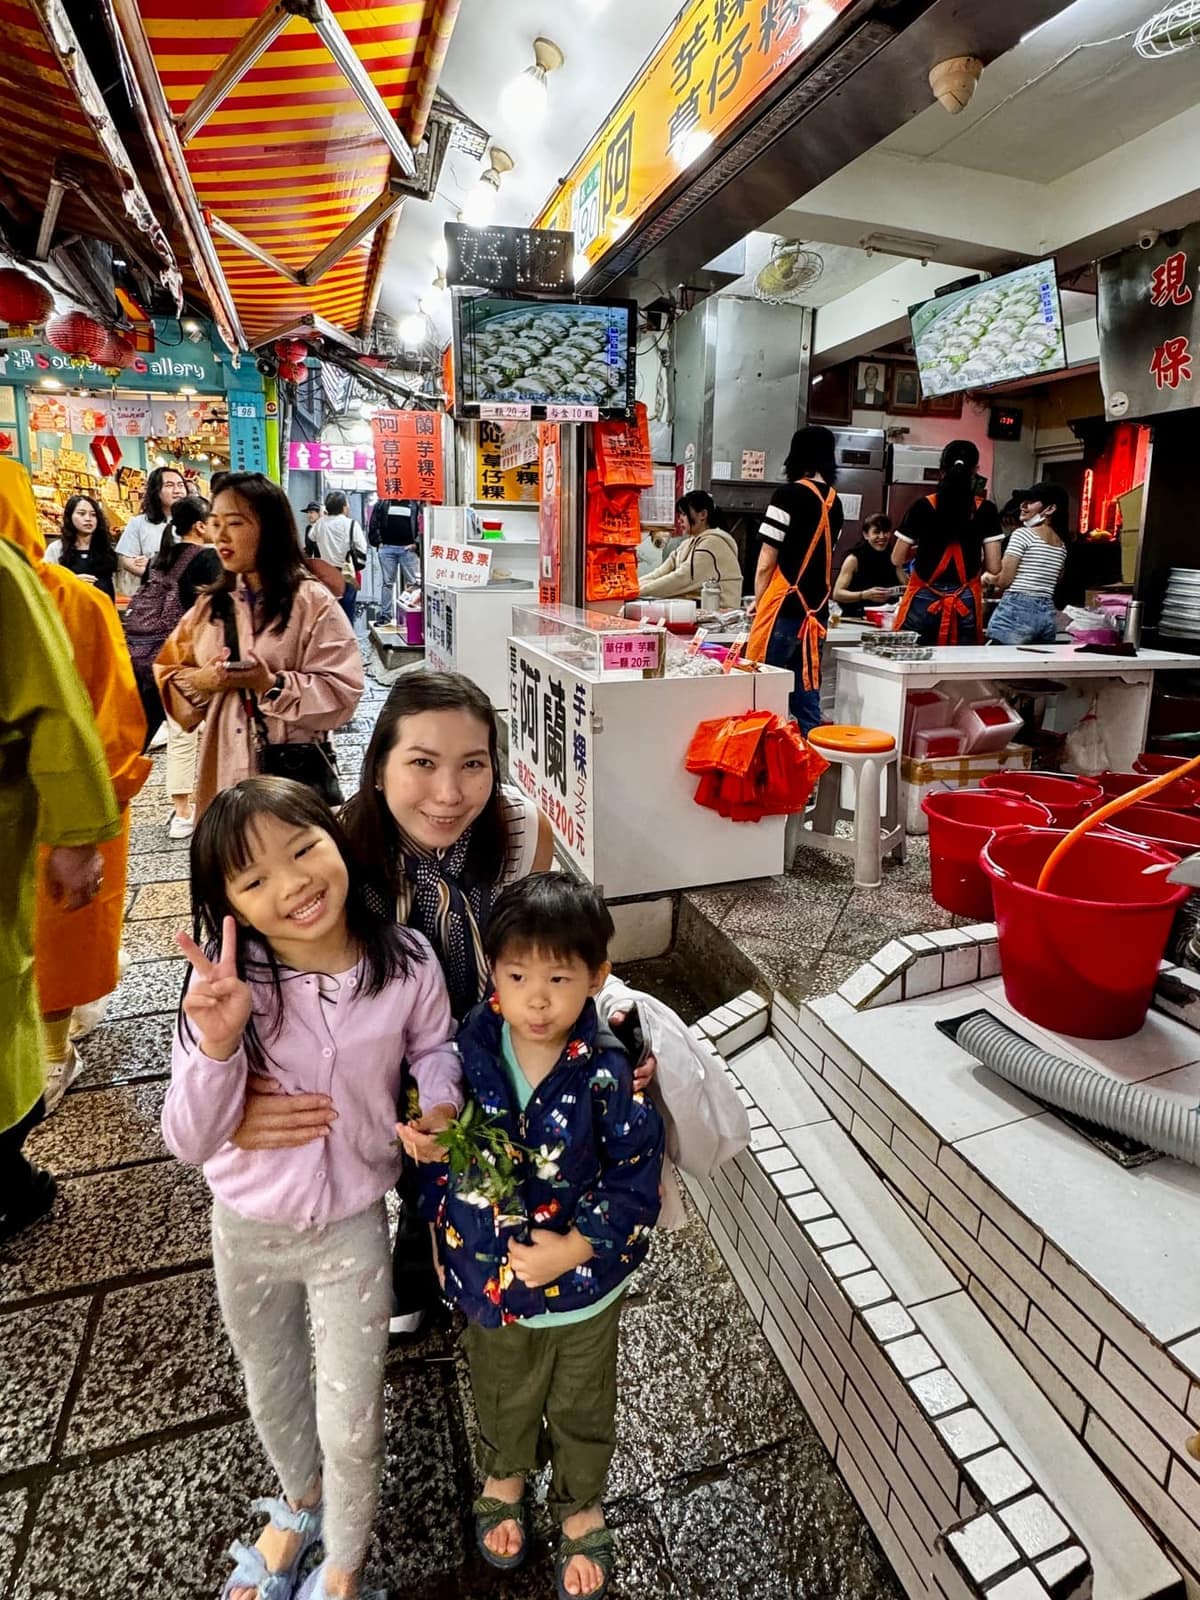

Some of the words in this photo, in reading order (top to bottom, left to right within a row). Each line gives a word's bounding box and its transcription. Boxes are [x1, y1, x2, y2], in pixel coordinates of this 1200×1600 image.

[601, 109, 635, 230] 阿
[133, 357, 205, 380] Gallery
[381, 440, 403, 495] 草仔粿
[481, 454, 505, 499] 草仔粿
[430, 544, 490, 567] 索取發票
[436, 568, 448, 580] get
[458, 571, 481, 584] receipt
[631, 656, 651, 668] 20元
[519, 658, 568, 798] 阿蘭
